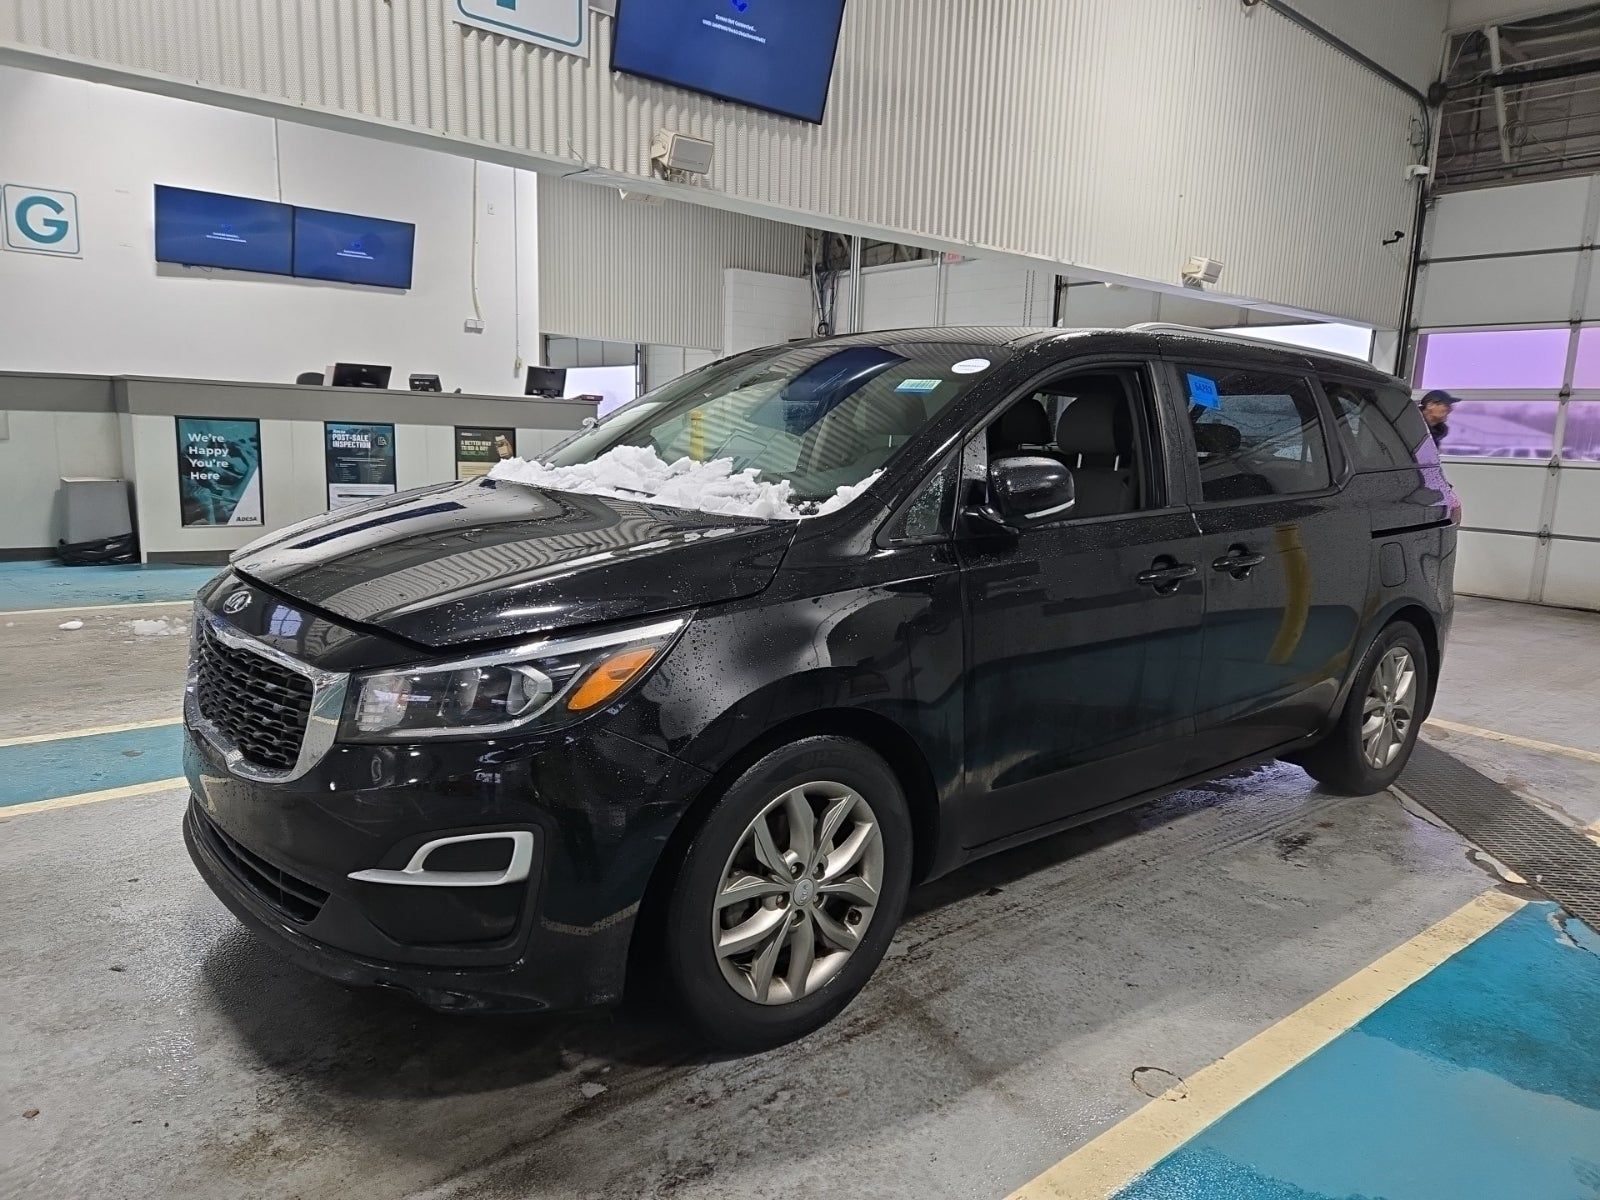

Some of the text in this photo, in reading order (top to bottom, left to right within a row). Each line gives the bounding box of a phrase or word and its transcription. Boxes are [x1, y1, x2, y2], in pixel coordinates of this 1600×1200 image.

[15, 196, 69, 244] G
[188, 433, 225, 443] We're
[332, 433, 369, 442] POST-SALE
[332, 441, 371, 449] INSPECTION
[189, 446, 229, 457] Happy
[190, 459, 229, 468] You're
[190, 471, 220, 480] Here
